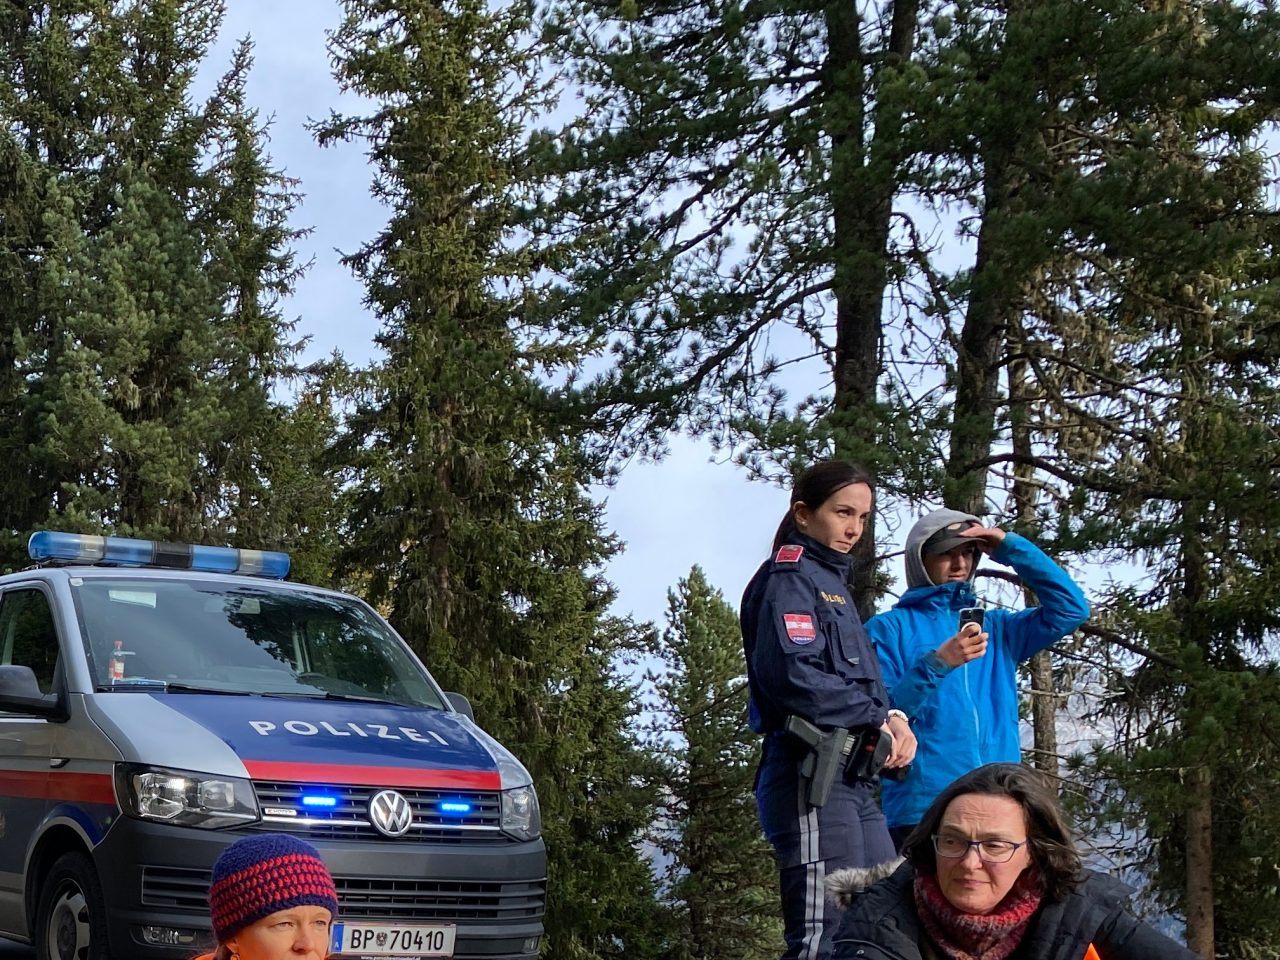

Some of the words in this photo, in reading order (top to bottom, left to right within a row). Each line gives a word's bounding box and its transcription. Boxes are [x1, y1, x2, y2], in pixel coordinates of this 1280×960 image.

[248, 720, 449, 746] POLIZEI
[350, 929, 375, 949] BP
[389, 930, 445, 951] 70410
